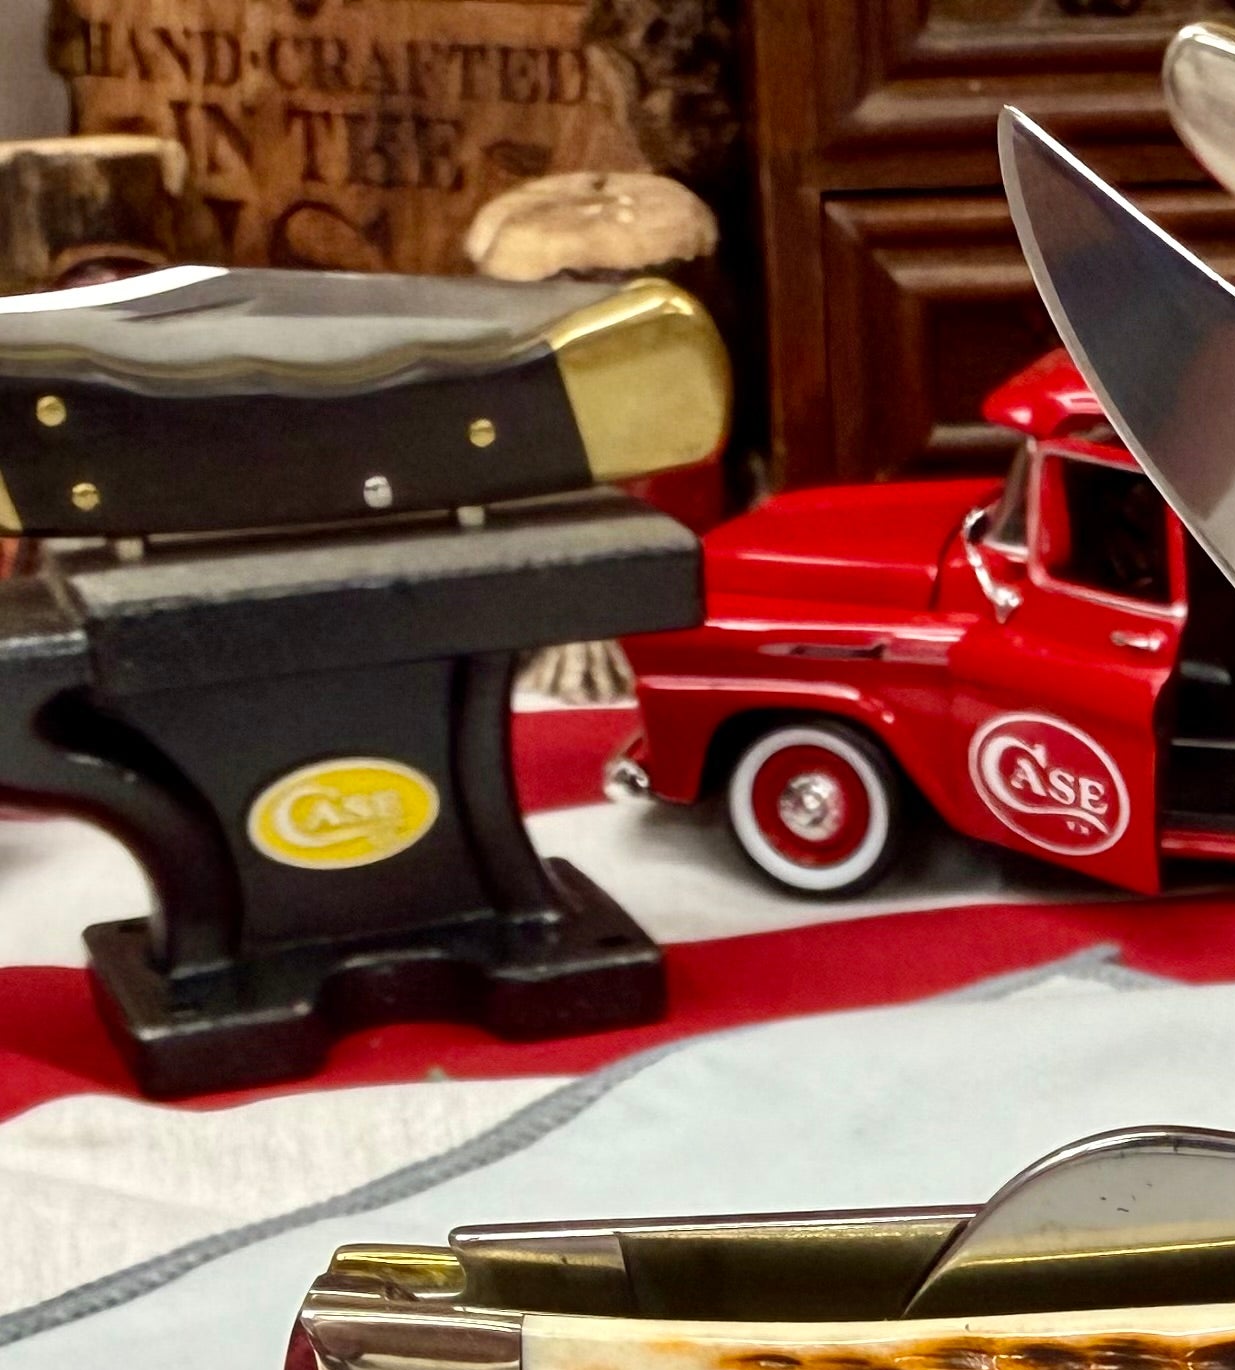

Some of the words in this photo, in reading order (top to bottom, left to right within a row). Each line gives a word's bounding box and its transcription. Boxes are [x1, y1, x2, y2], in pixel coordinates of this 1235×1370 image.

[285, 104, 466, 190] THE
[275, 785, 402, 848] CASE
[981, 736, 1108, 834] CASE
